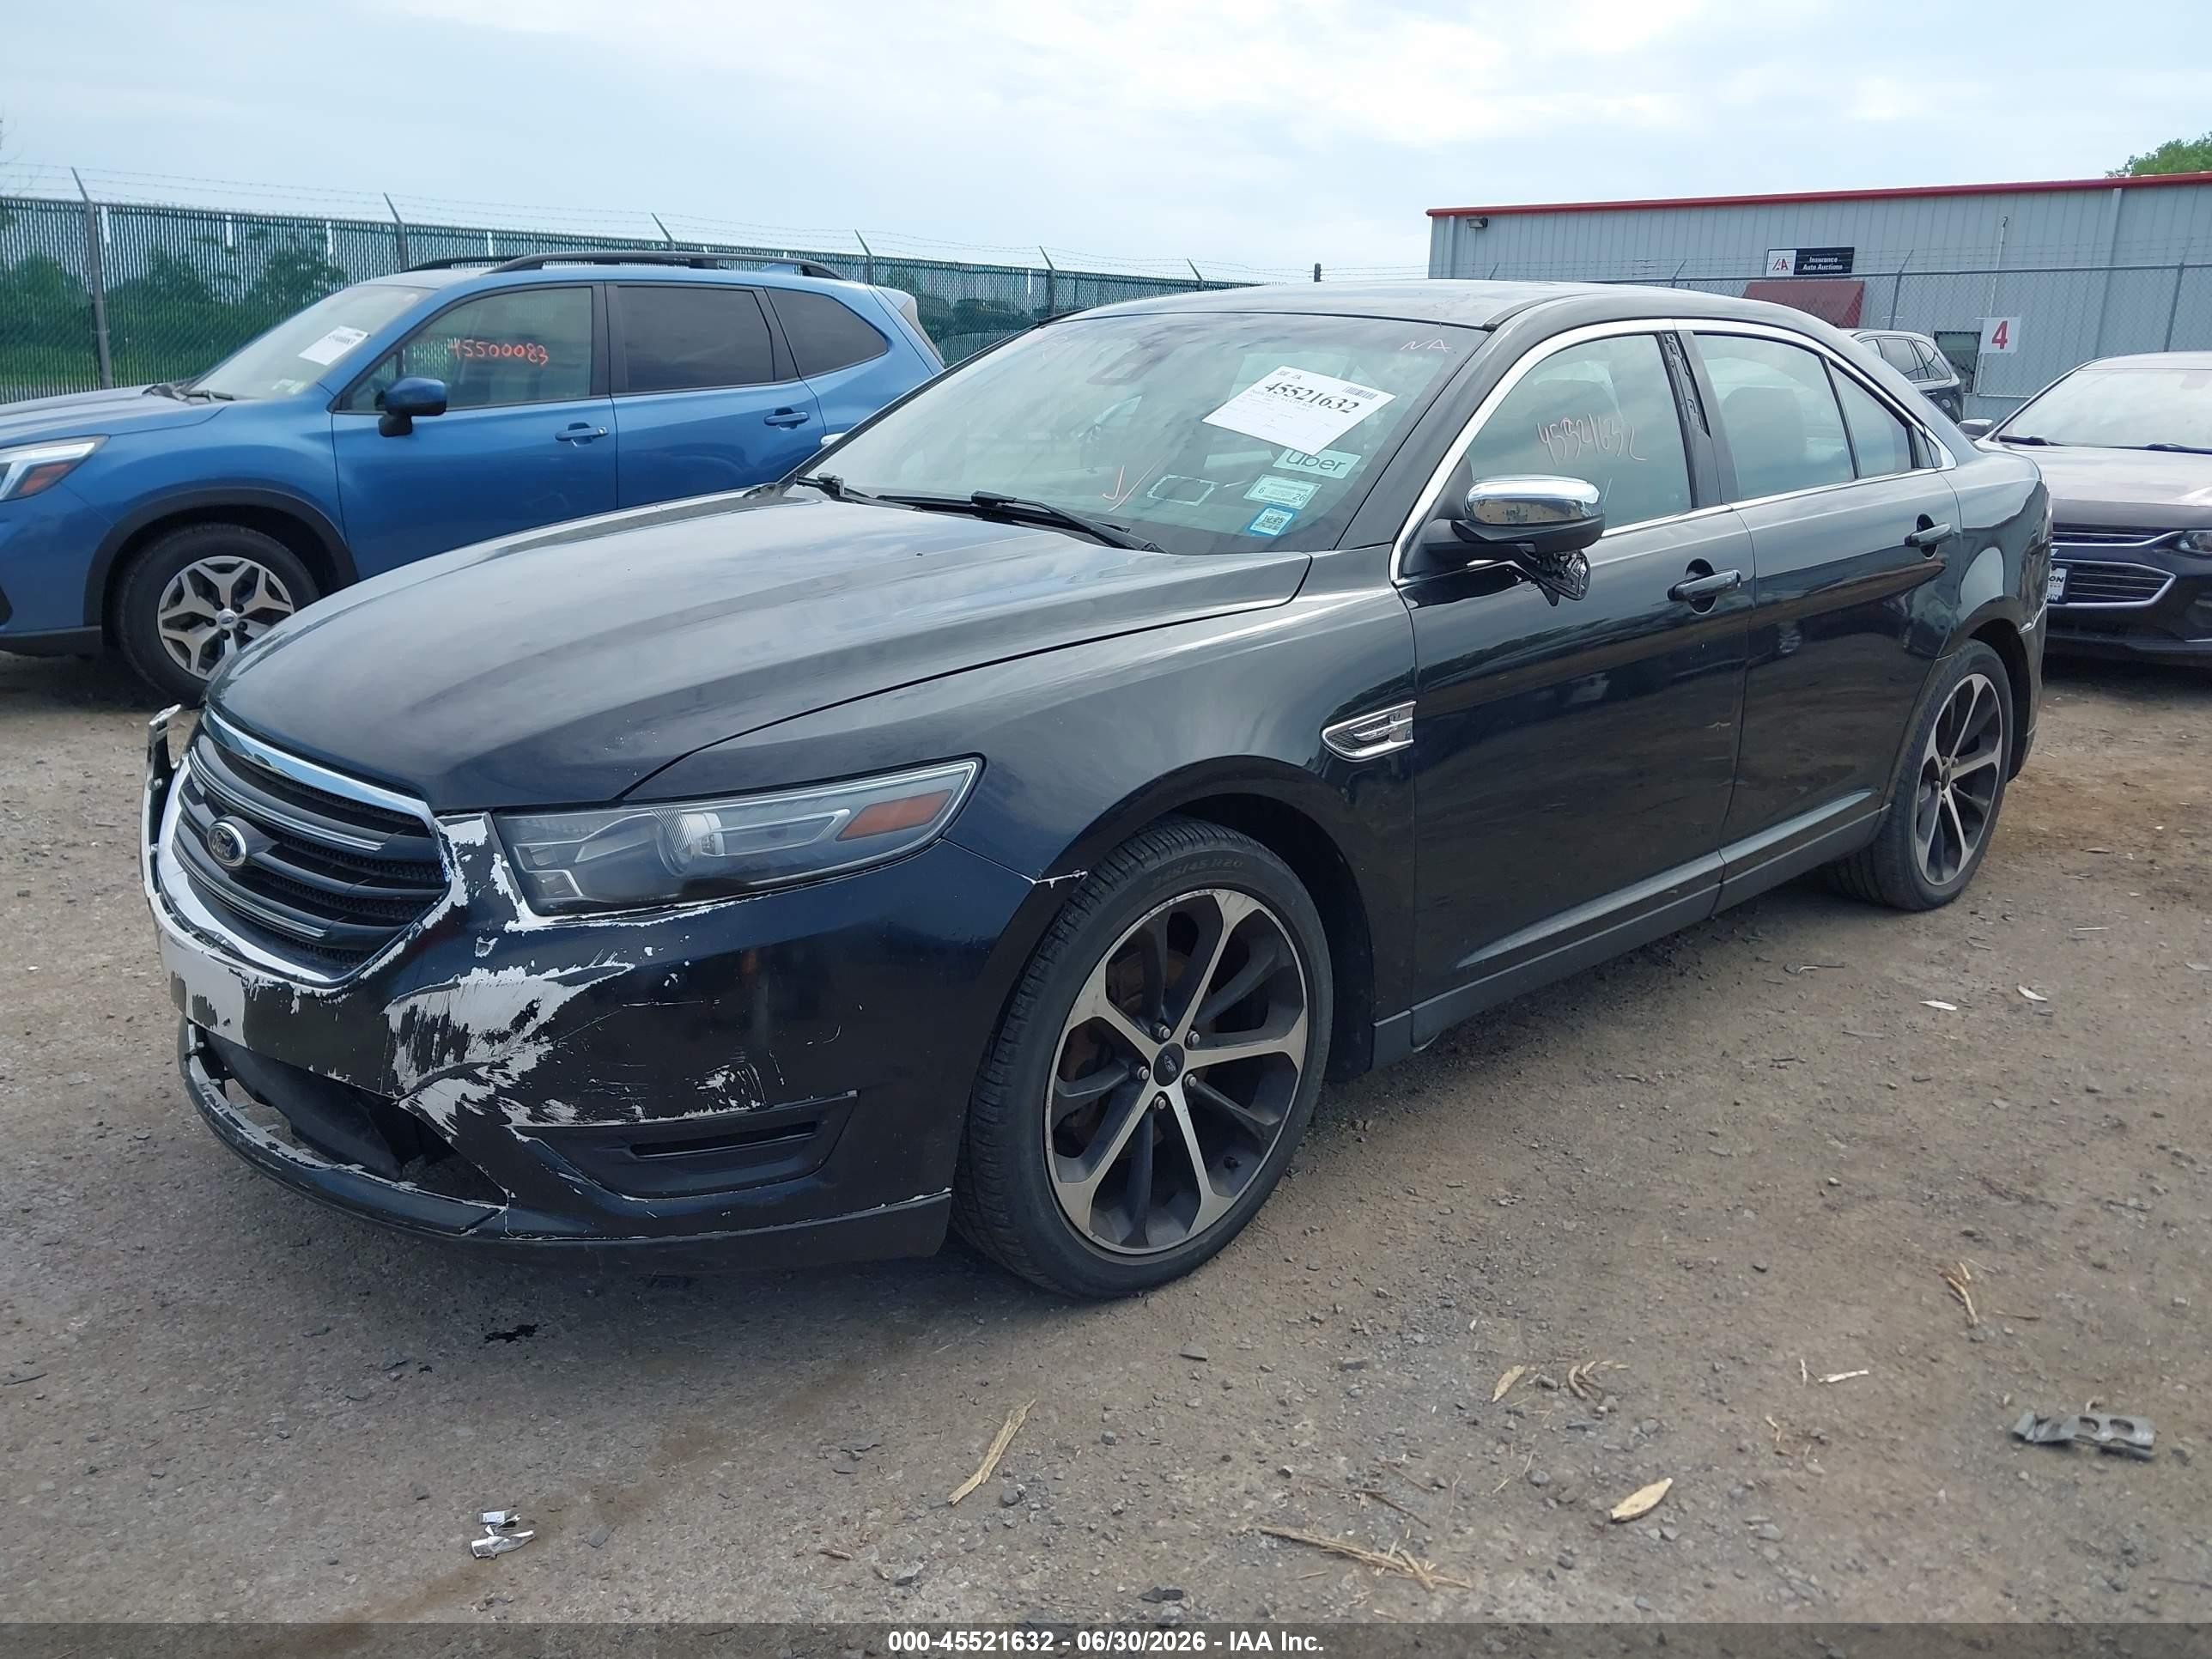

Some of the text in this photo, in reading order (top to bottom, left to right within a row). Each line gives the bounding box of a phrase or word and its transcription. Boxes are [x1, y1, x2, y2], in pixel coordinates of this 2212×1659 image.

[1991, 319, 2008, 349] 4
[447, 337, 549, 366] 45500083
[1264, 381, 1360, 414] 45521632
